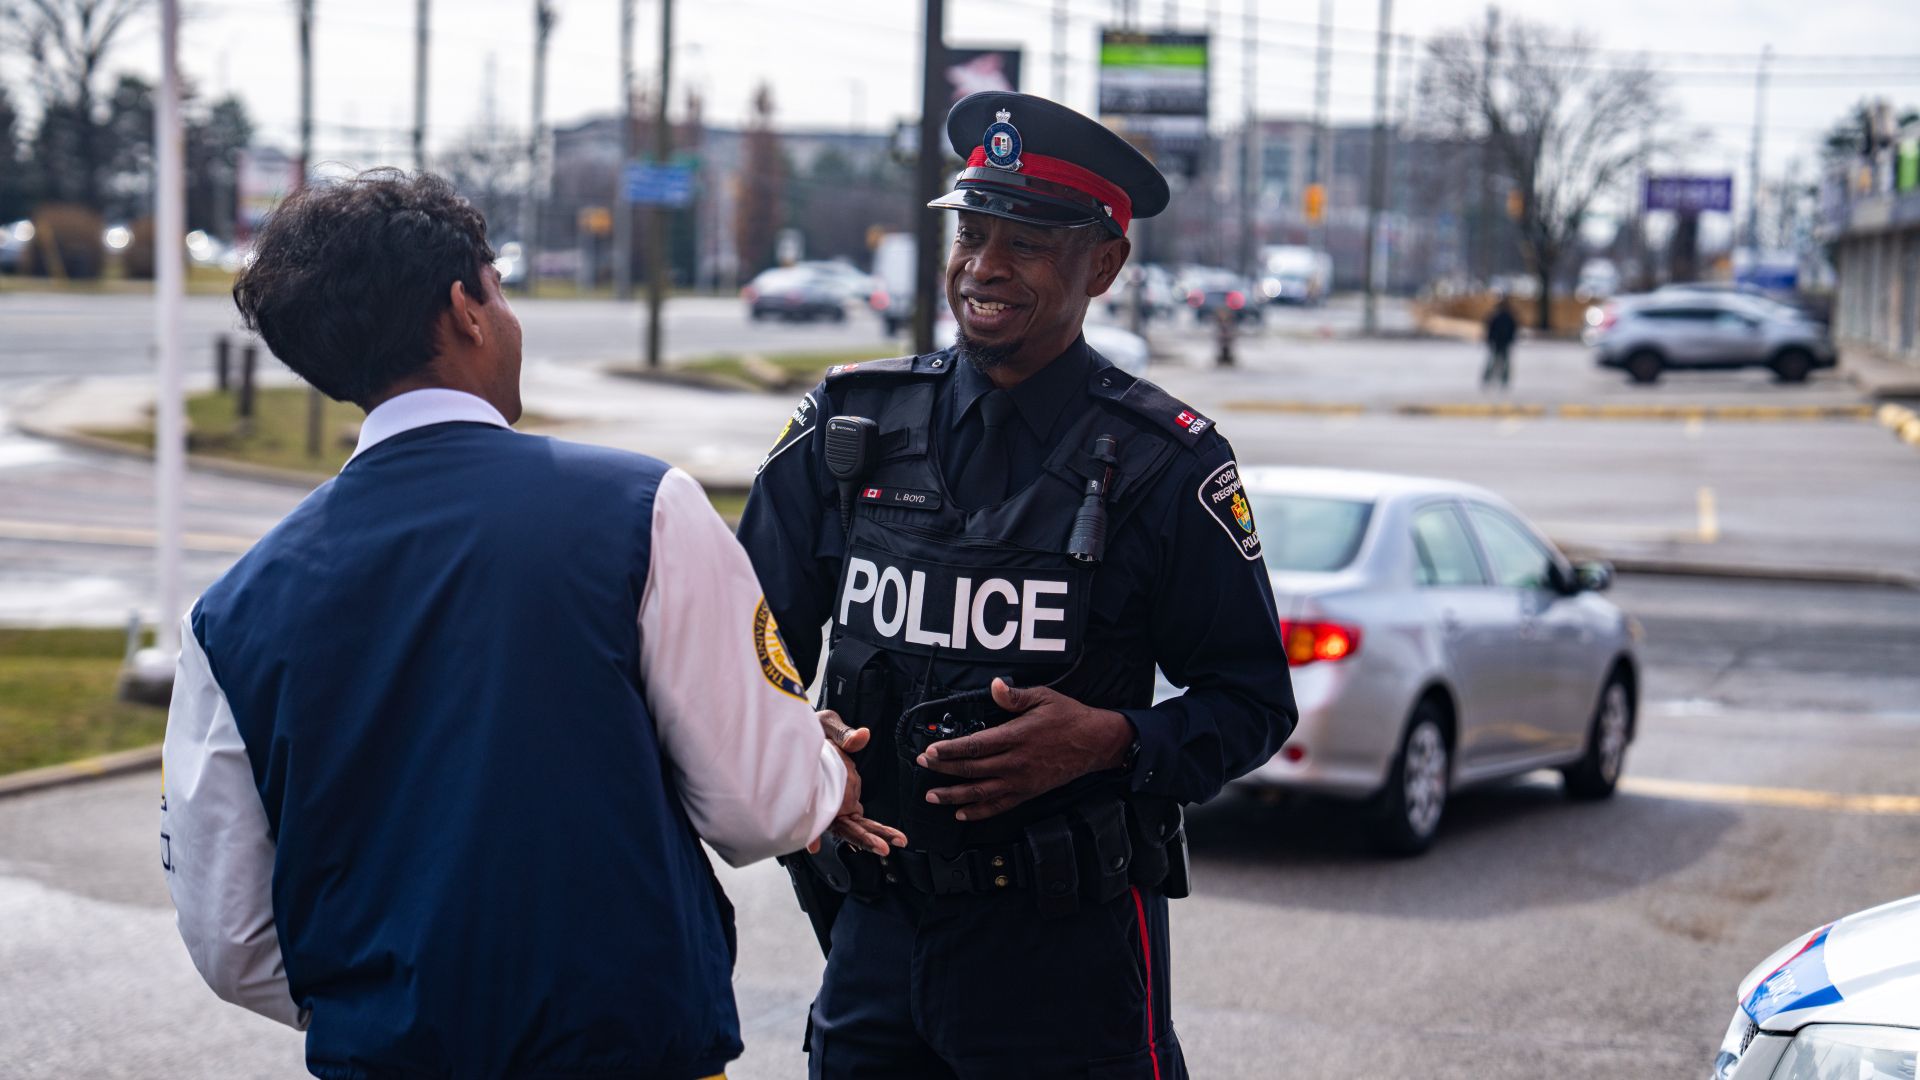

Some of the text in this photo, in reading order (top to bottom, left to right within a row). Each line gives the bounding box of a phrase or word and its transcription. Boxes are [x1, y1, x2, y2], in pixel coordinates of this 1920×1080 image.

[1215, 468, 1237, 487] YORK
[894, 492, 926, 503] L. BOYD
[839, 556, 1068, 651] POLICE
[764, 663, 785, 687] THE
